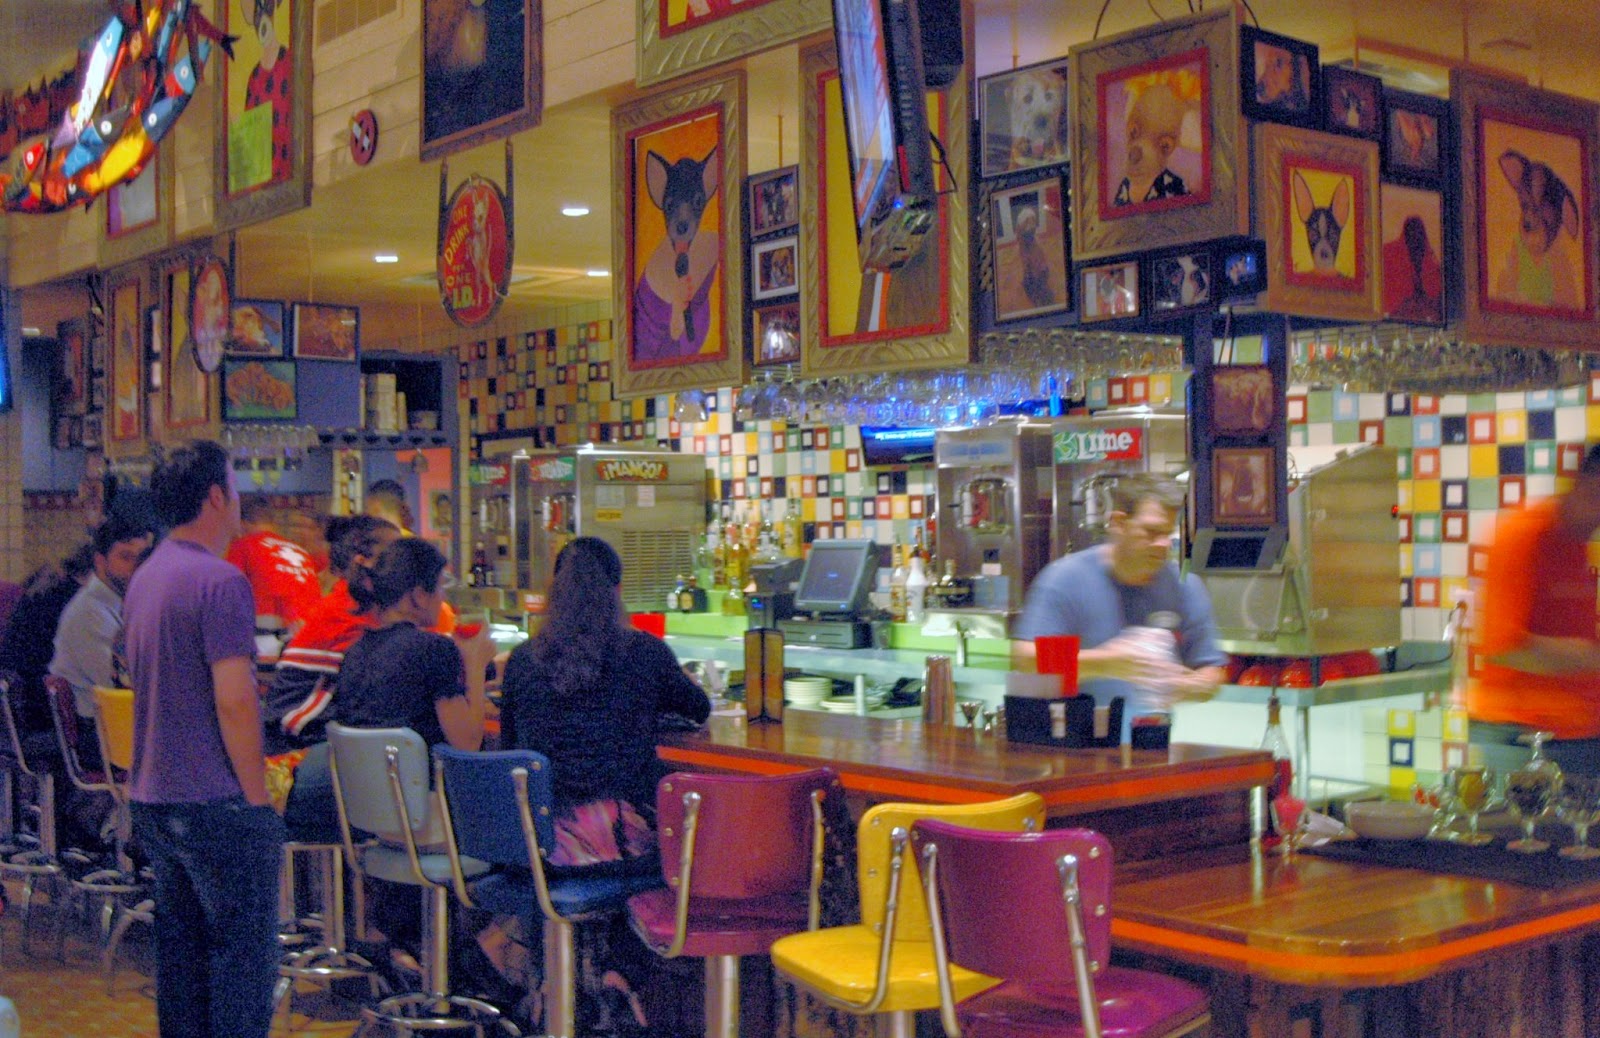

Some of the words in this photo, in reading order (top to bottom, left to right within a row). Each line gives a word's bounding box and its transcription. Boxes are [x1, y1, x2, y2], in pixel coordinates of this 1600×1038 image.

[444, 223, 470, 265] DRINK
[446, 272, 472, 288] ONE
[1076, 431, 1134, 460] Lime
